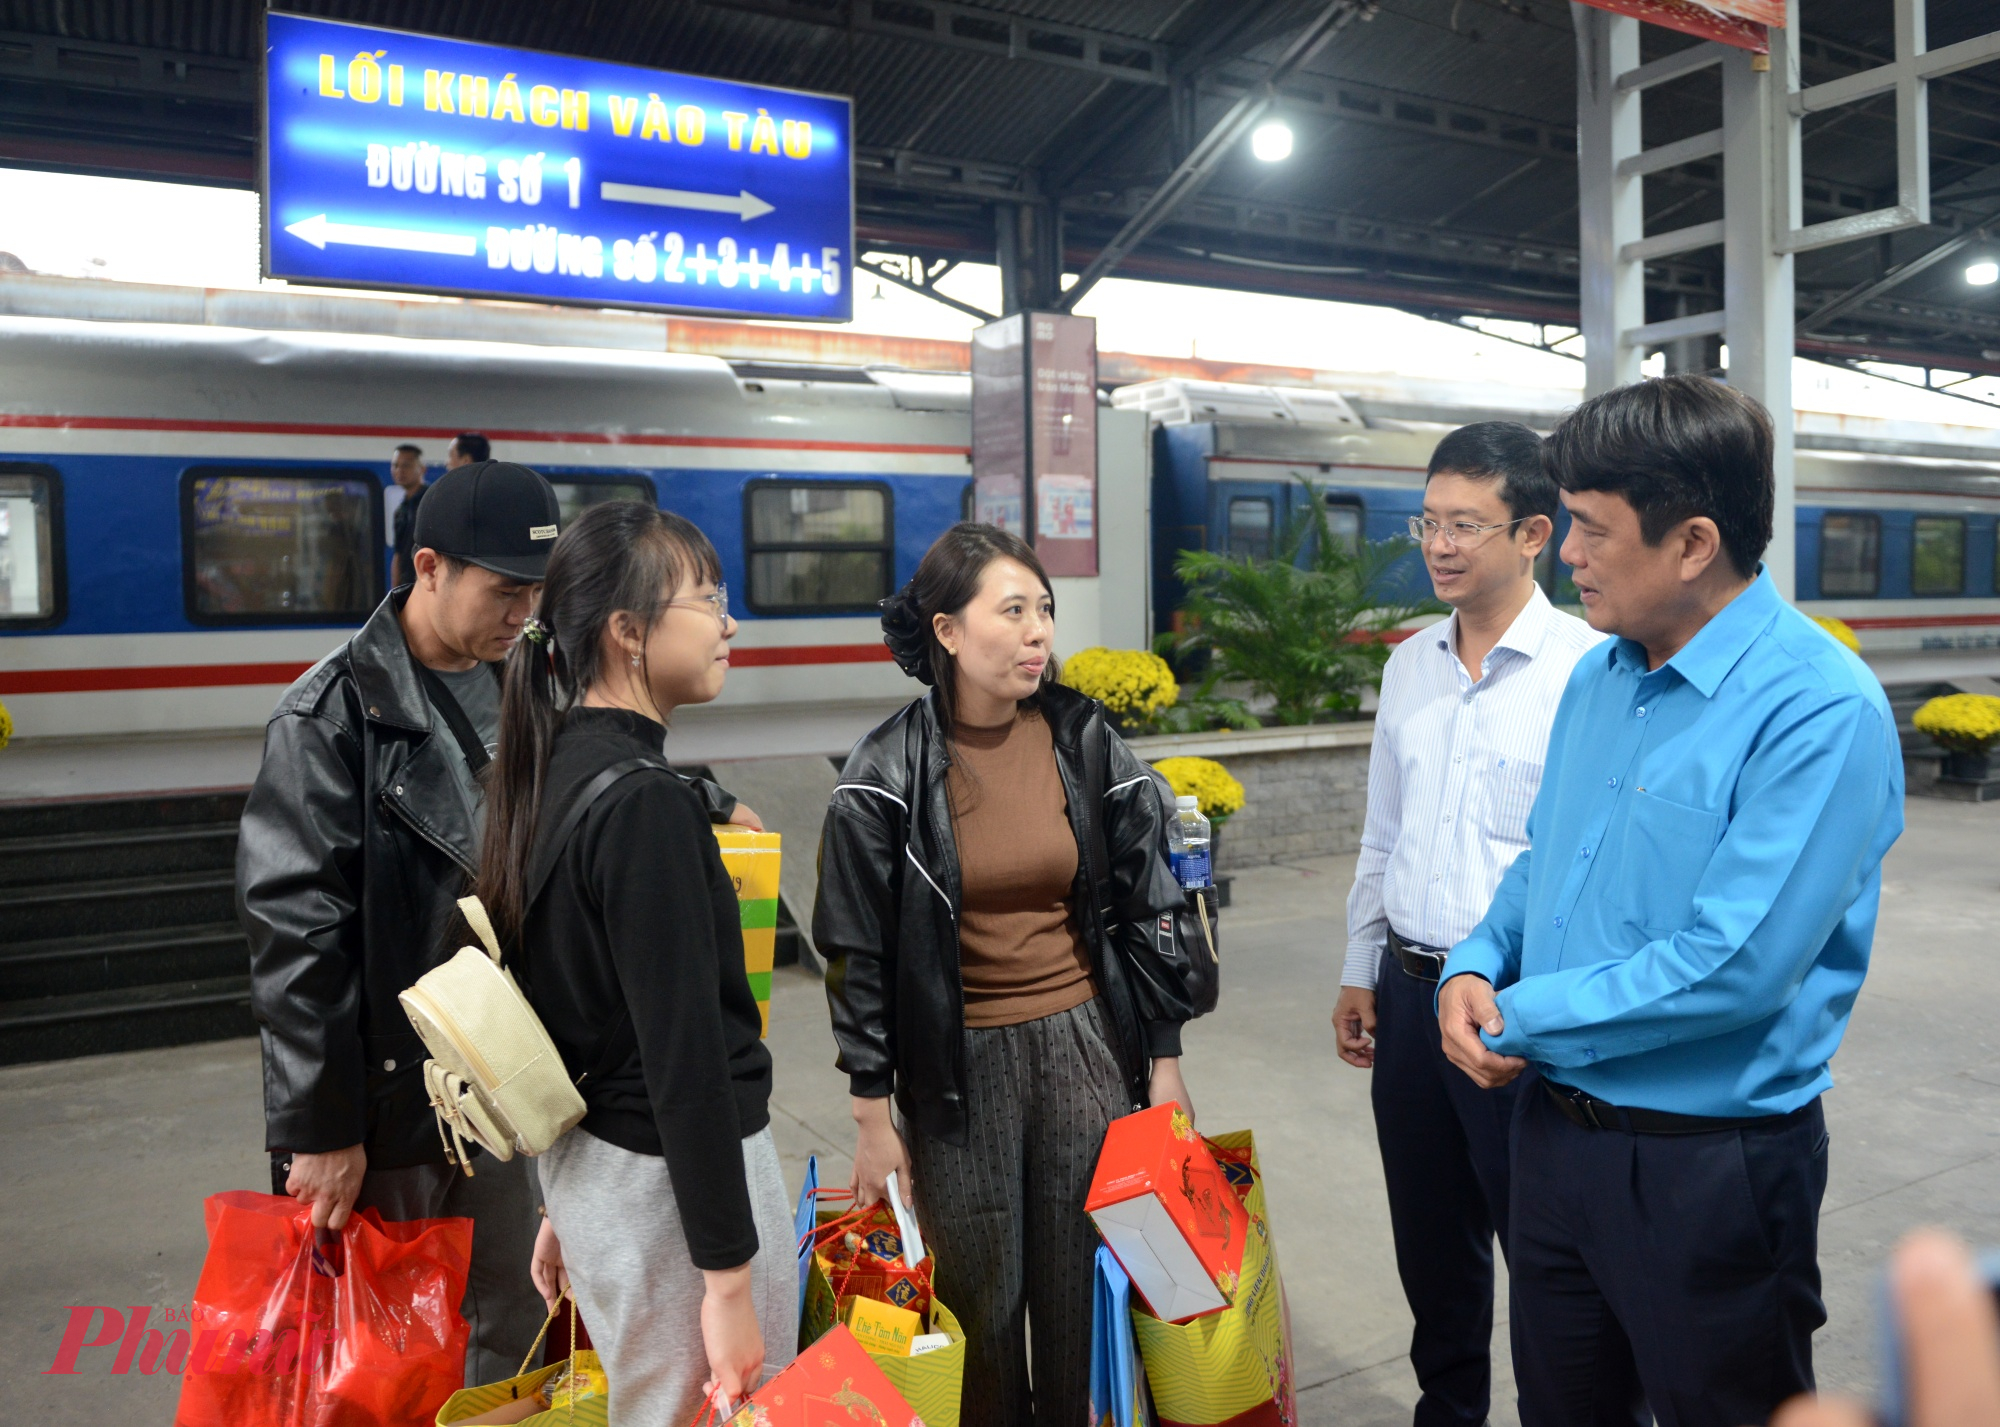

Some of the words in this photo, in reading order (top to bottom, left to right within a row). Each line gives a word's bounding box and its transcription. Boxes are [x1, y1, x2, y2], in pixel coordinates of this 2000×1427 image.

[319, 49, 405, 107] LỐI
[423, 72, 590, 132] KHÁCH
[609, 92, 706, 147] VÀO
[722, 107, 813, 160] TÀU
[365, 141, 487, 200] ĐƯỜNG
[498, 152, 545, 206] SỐ
[564, 157, 582, 210] 1
[485, 225, 603, 279] ĐƯỜNG
[613, 231, 659, 284] SỐ
[664, 231, 841, 296] 2+3+4+5
[856, 1316, 872, 1335] Chè
[875, 1321, 891, 1340] Tôm
